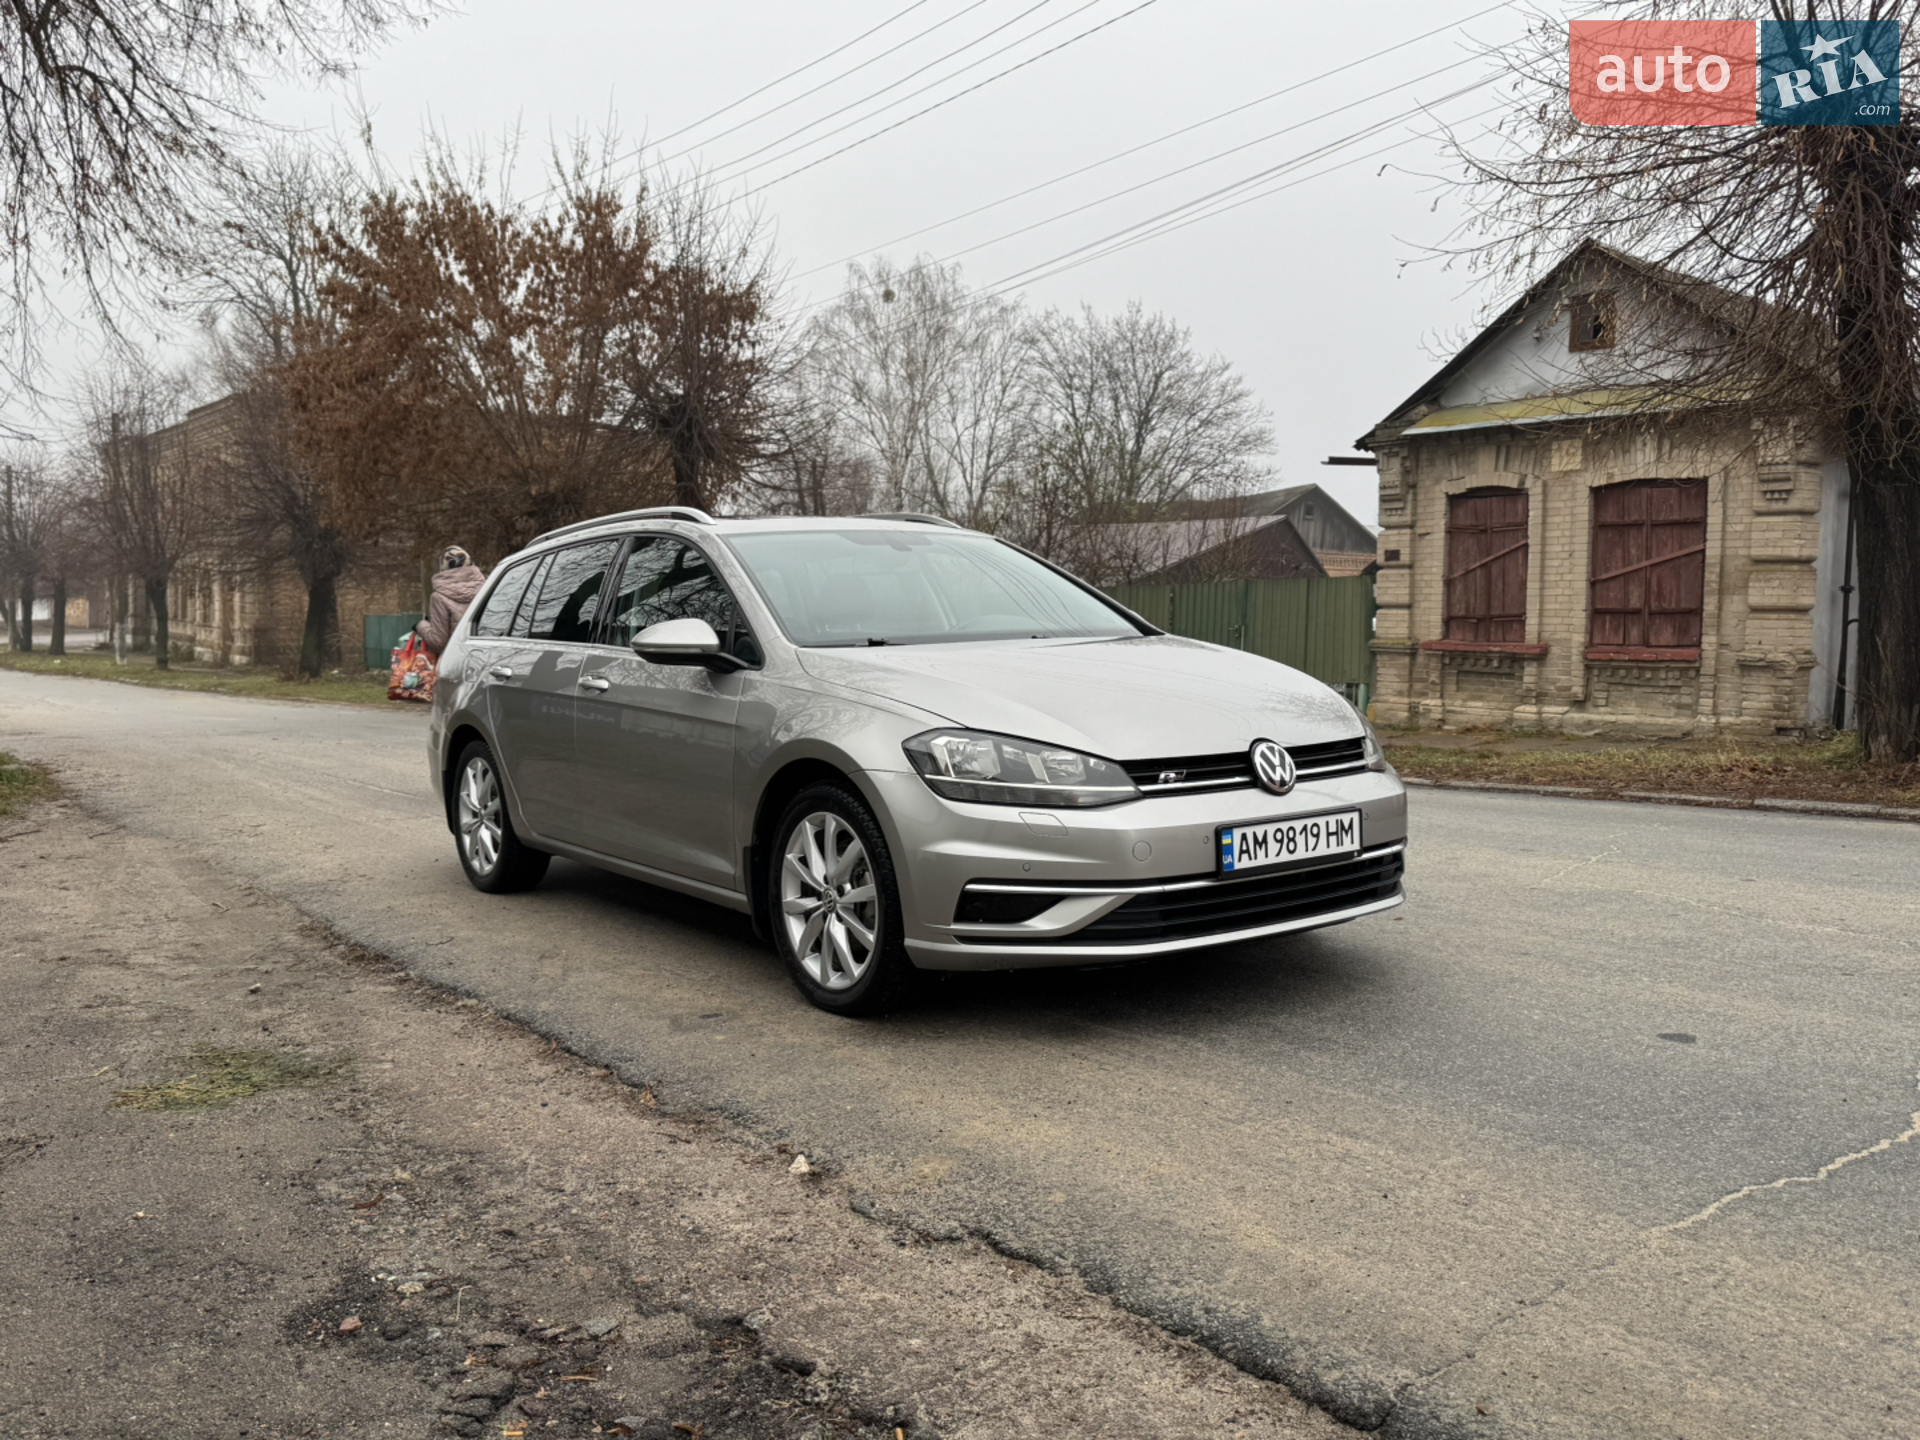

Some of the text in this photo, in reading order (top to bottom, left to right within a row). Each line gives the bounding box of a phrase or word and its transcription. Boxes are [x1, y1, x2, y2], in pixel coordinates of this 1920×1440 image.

[1237, 816, 1354, 863] AM 9819 HM
